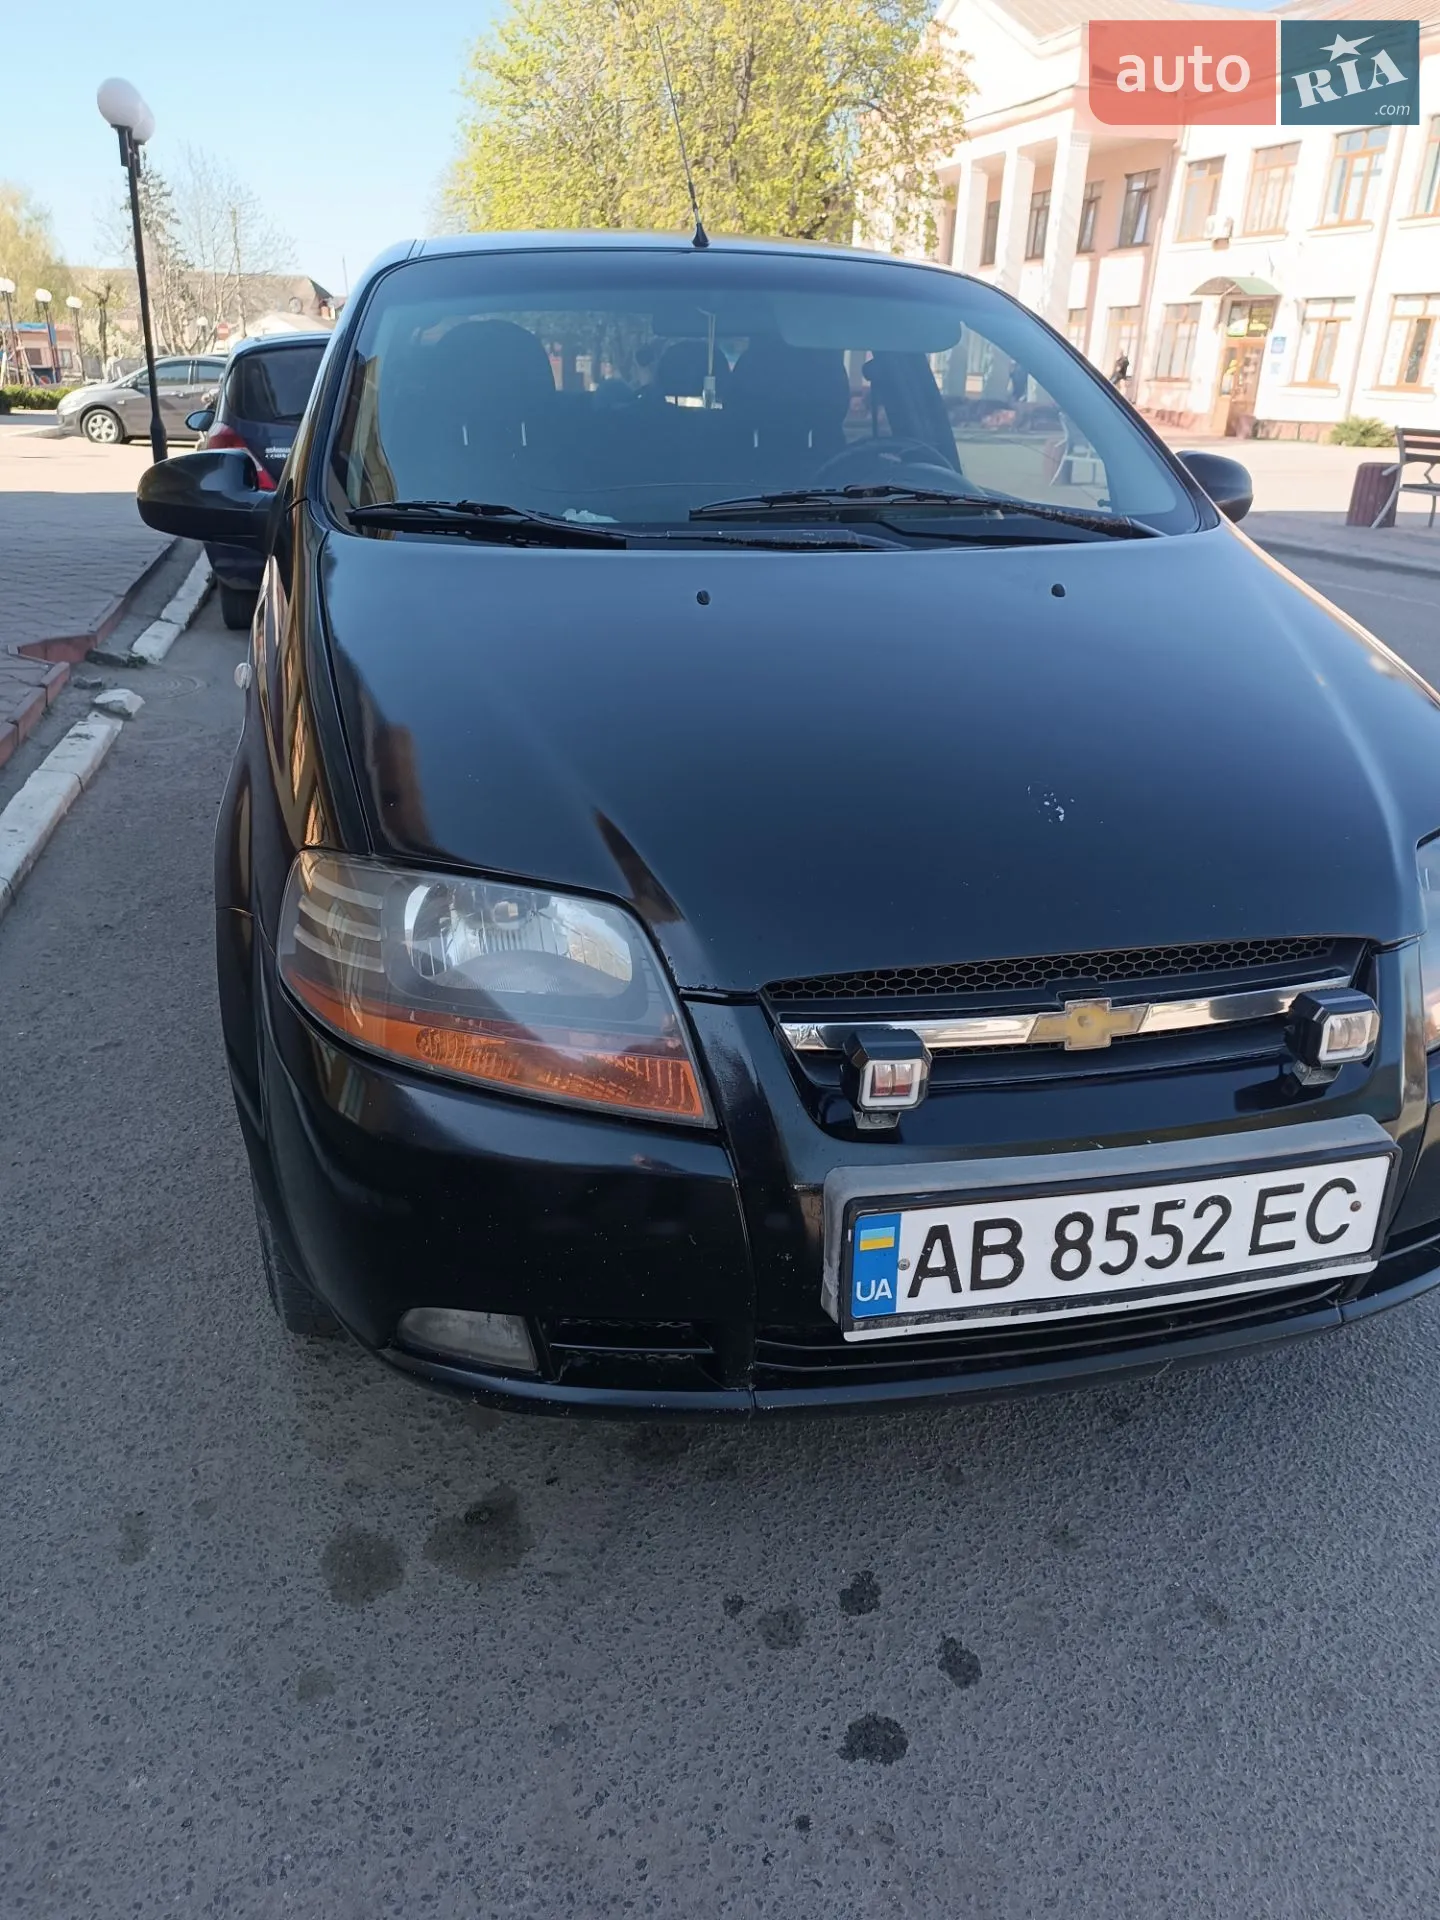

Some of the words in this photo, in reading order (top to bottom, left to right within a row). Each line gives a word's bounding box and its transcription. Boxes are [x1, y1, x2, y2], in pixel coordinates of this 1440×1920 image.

[907, 1216, 1025, 1298] AB
[1049, 1194, 1232, 1281] 8552
[1248, 1177, 1357, 1256] EC
[855, 1278, 893, 1302] UA
